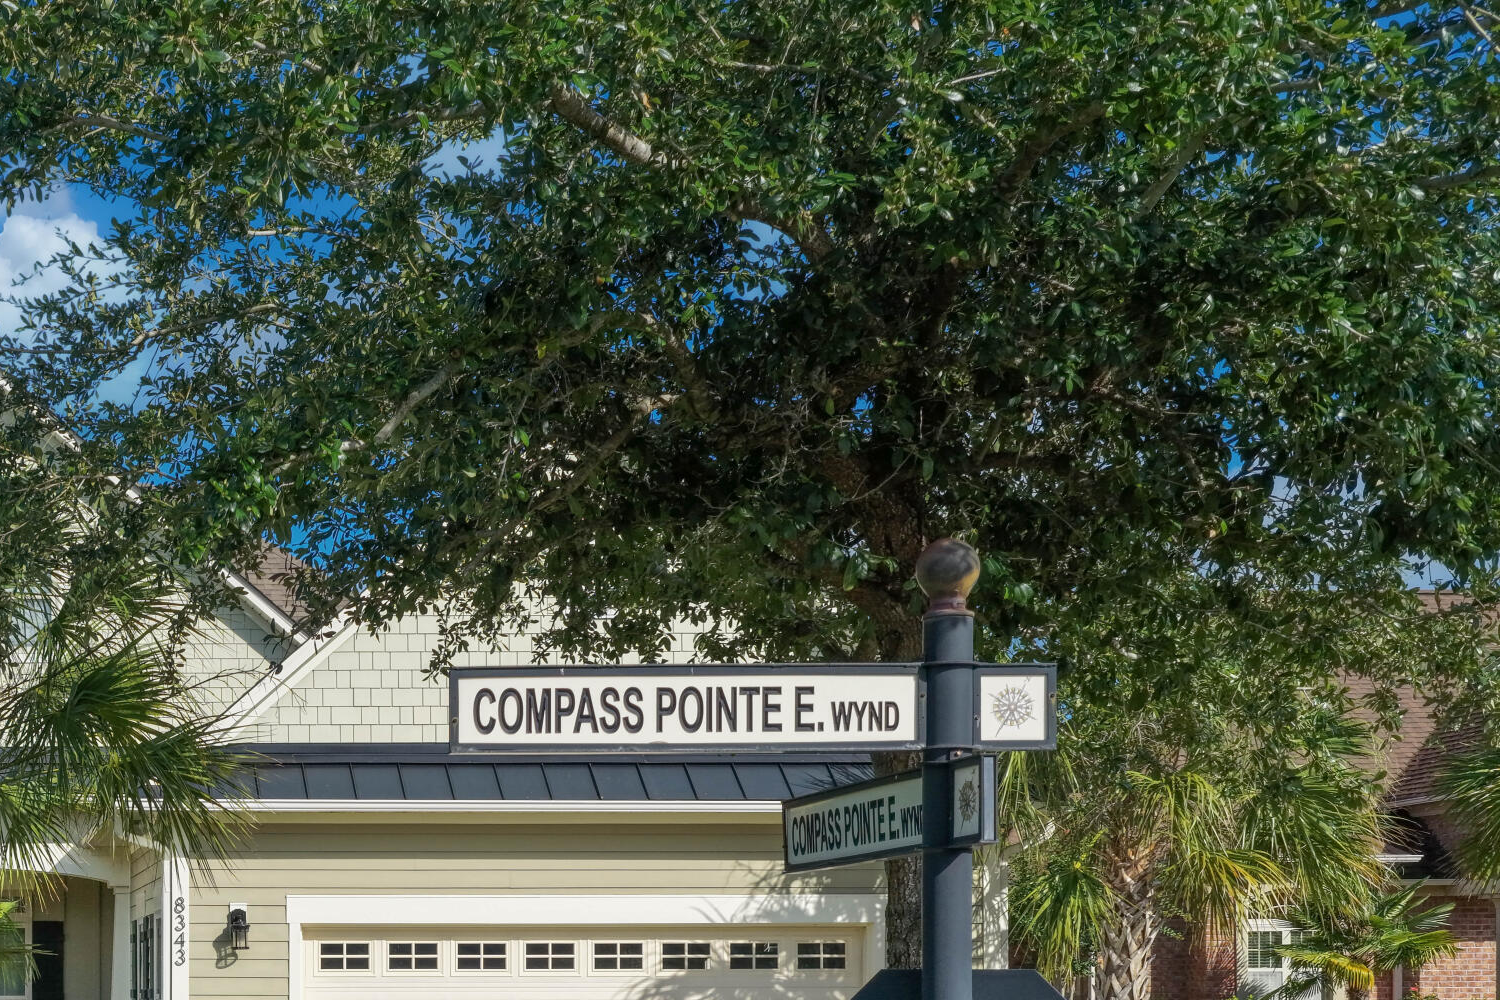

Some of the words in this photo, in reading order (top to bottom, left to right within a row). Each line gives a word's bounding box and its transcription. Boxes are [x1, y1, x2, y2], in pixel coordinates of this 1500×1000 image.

[472, 685, 645, 736] COMPASS
[655, 684, 782, 734] POINTE
[793, 685, 824, 733] E.
[830, 700, 900, 733] WYND
[791, 808, 841, 857] COMPASS
[844, 797, 885, 849] POINTE
[888, 796, 899, 839] E.
[173, 896, 185, 966] 8343
